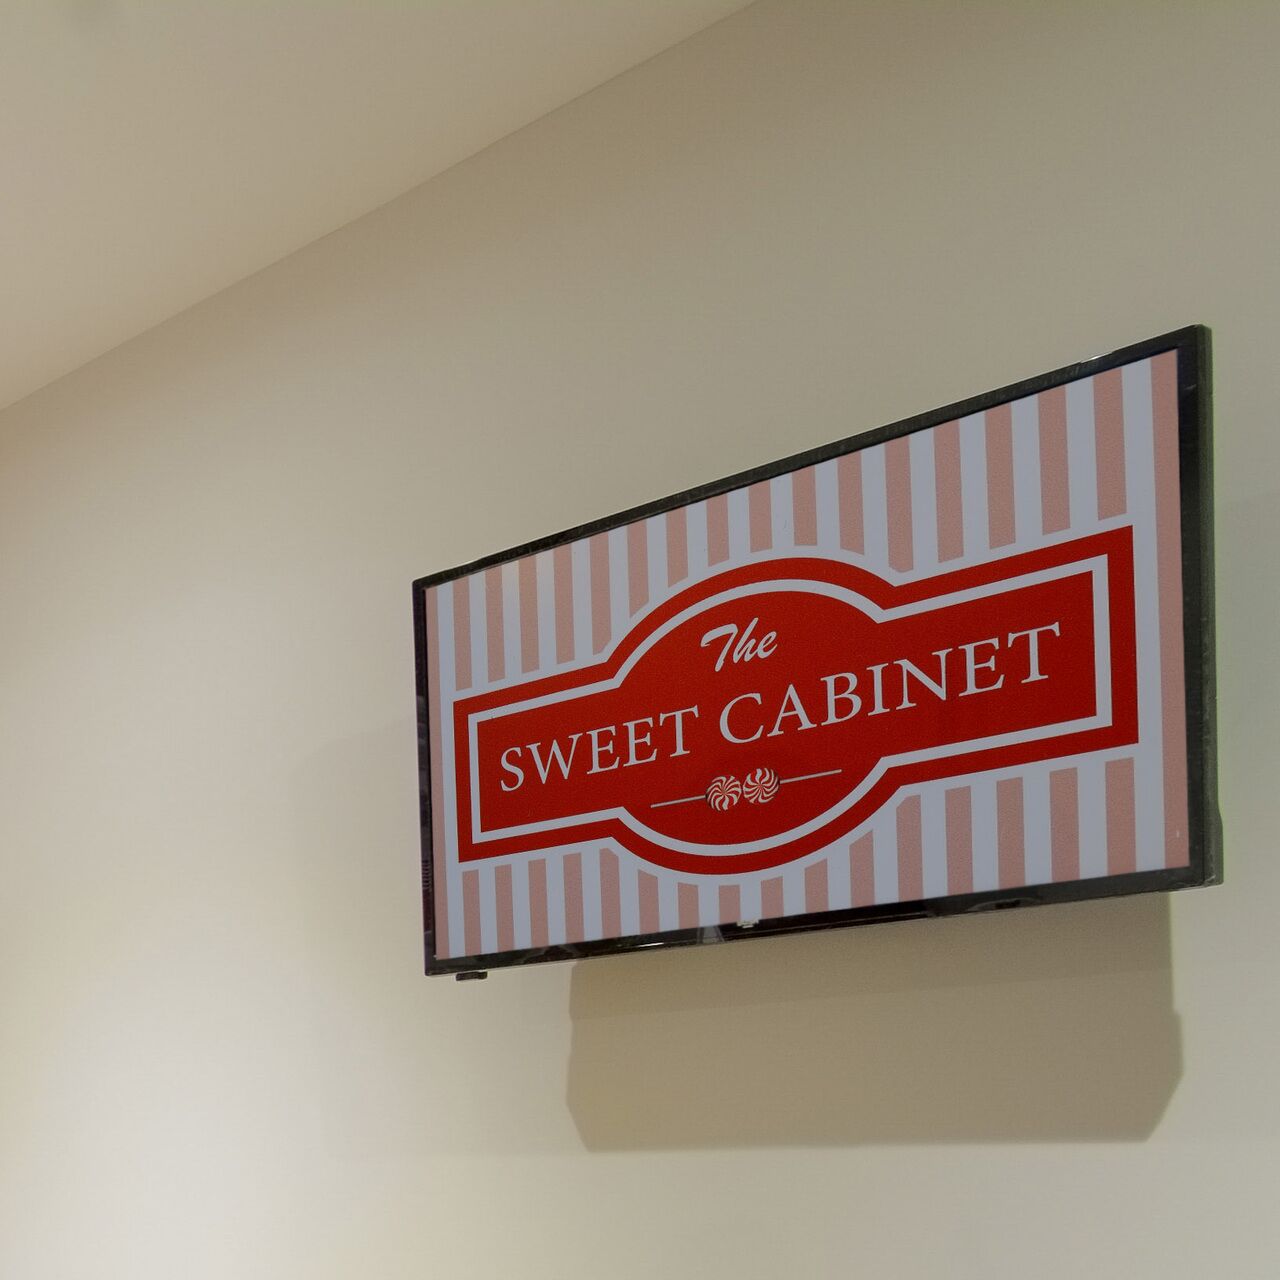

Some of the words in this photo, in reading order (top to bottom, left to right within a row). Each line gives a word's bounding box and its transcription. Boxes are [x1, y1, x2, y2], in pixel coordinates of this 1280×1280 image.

[700, 617, 778, 672] The
[499, 705, 699, 792] SWEET
[719, 622, 1062, 744] CABINET
